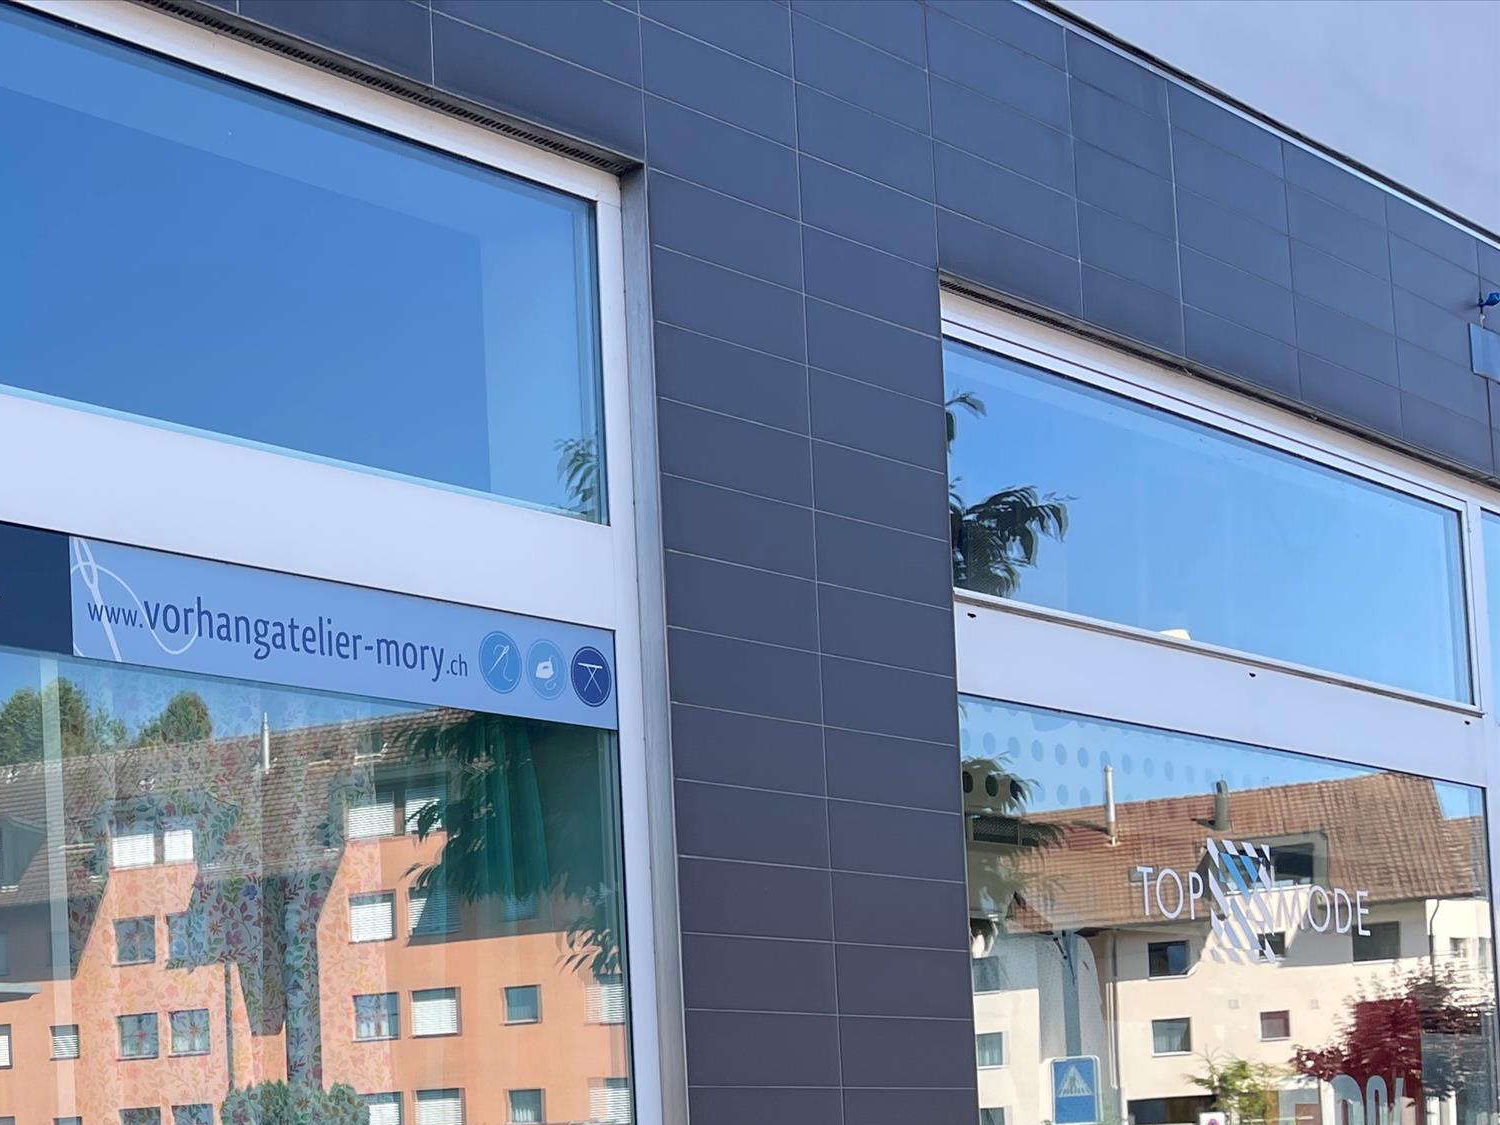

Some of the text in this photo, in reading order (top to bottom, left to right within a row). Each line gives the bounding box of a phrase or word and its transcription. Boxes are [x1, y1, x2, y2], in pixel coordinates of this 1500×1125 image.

[87, 596, 468, 682] www.vorhangatelier-mory.ch
[1136, 866, 1371, 937] TOP MODE
